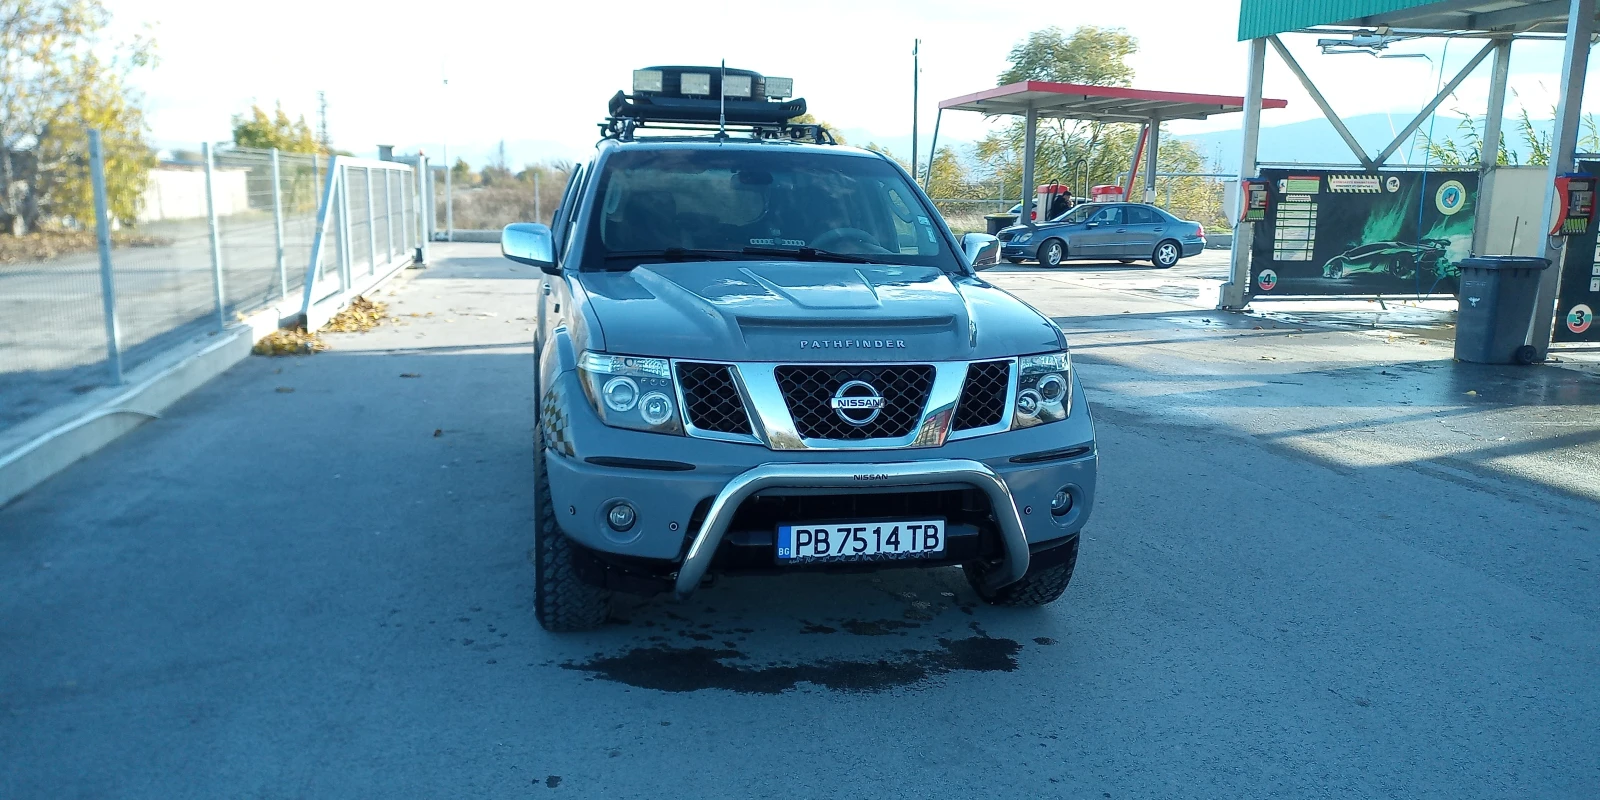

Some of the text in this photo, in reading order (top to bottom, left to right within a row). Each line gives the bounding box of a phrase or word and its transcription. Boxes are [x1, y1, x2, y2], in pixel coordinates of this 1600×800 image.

[1262, 273, 1272, 286] 4
[1573, 310, 1585, 327] 3
[800, 339, 906, 349] PATHFINDER
[837, 399, 881, 408] NISSAN
[853, 473, 889, 481] NISSAN
[795, 524, 940, 556] PB 7514 TB
[778, 547, 790, 556] BG
